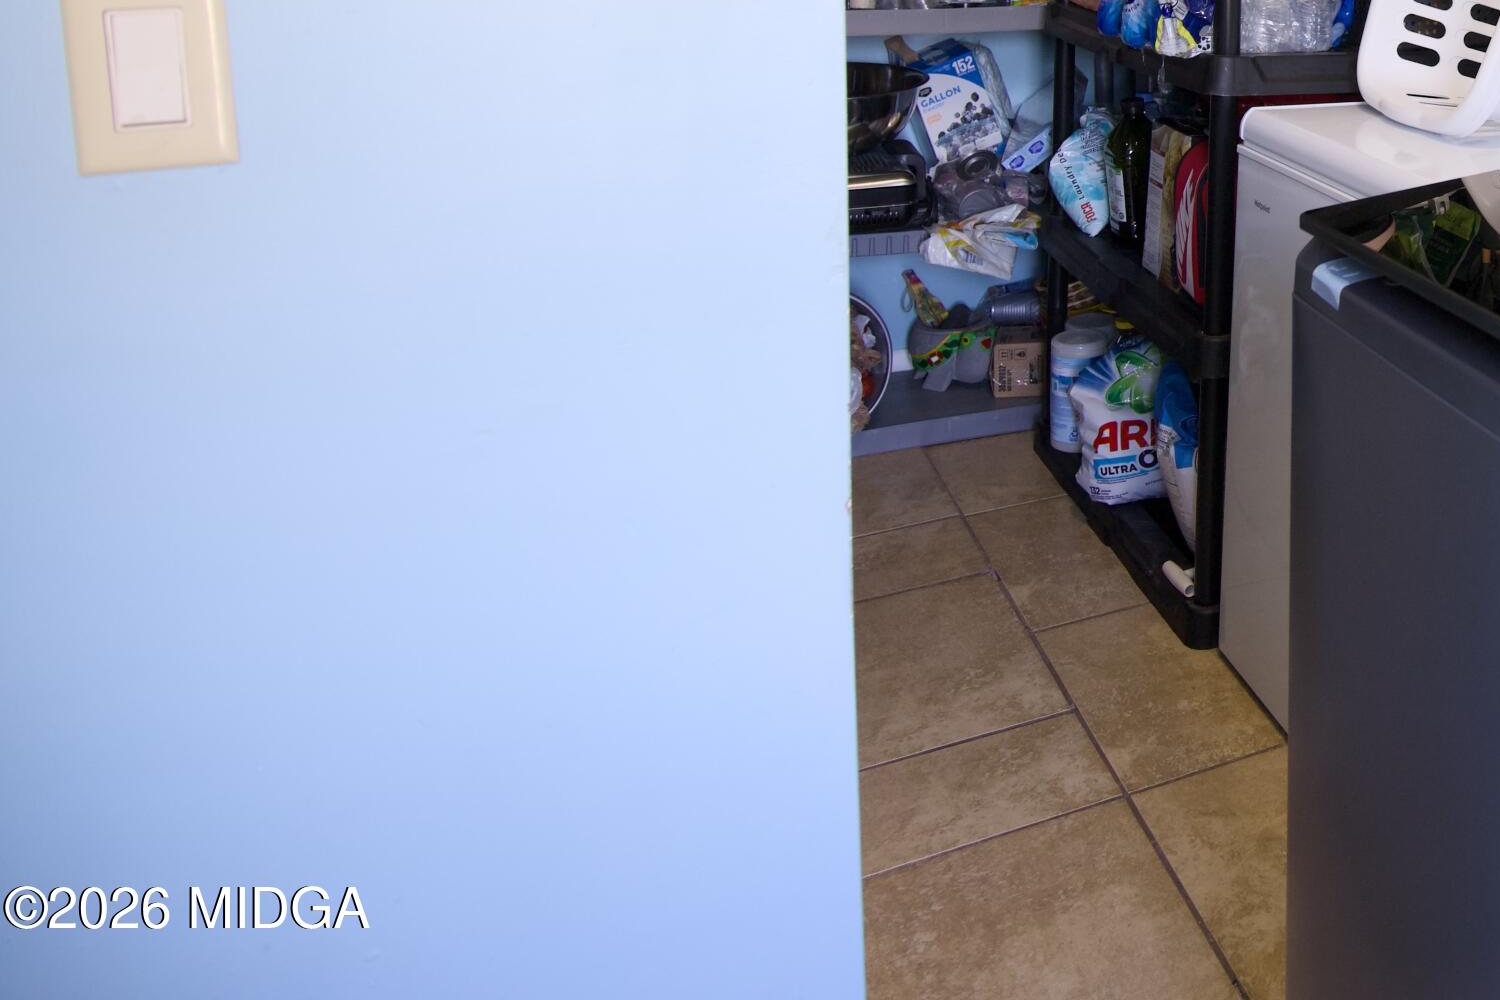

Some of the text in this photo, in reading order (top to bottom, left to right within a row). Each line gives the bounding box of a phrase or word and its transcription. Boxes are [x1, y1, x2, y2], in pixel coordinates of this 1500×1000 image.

[951, 56, 976, 75] 152
[920, 85, 962, 109] GALLON
[1063, 165, 1086, 200] Laundry
[1100, 463, 1138, 476] ULTRA
